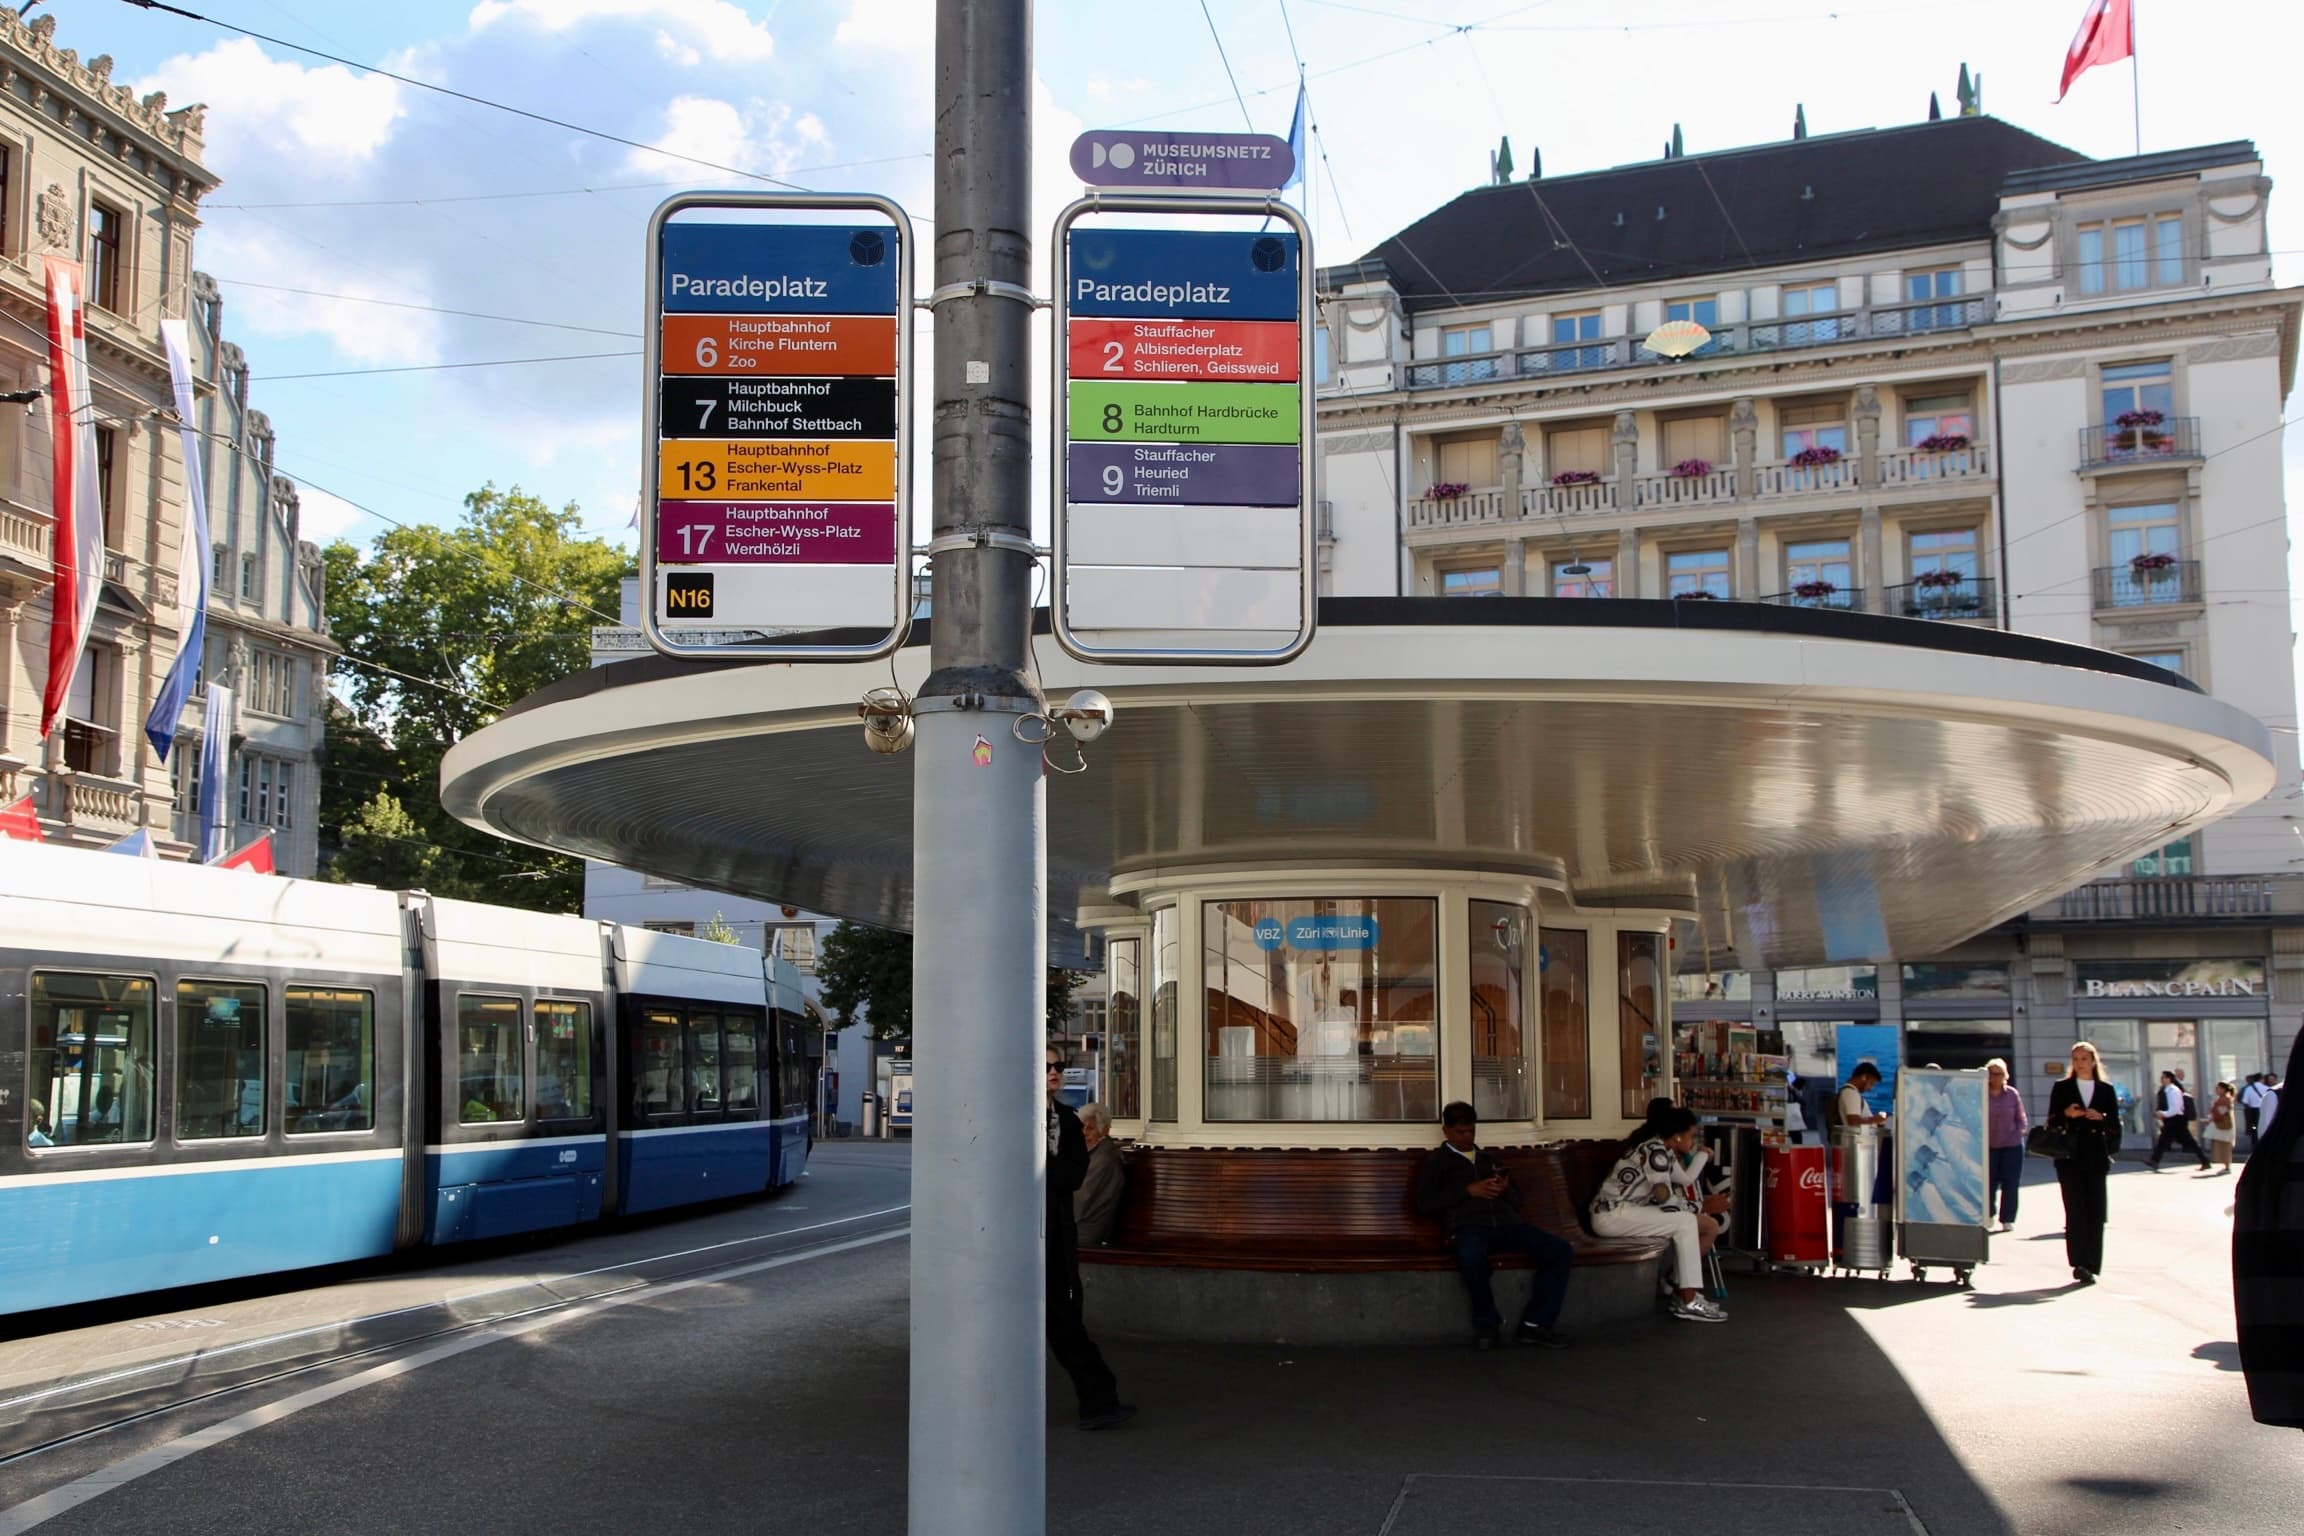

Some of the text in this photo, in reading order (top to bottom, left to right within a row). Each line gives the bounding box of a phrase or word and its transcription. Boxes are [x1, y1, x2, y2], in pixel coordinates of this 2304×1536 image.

[1143, 144, 1271, 159] MUSEUMSNETZ
[1143, 160, 1207, 176] ZÜRICH
[672, 274, 828, 301] Paradeplatz
[1078, 279, 1230, 307] Paradeplatz
[729, 321, 831, 335] Hauptbahnhof
[1134, 325, 1215, 338] Stauffacher
[729, 338, 837, 350] Kirche Fluntern
[1134, 343, 1243, 358] Albisriederplatz
[696, 337, 718, 368] 6
[1103, 342, 1124, 372] 2
[728, 356, 756, 367] Zoo
[1134, 360, 1279, 375] Schlieren, Geissweid
[728, 383, 831, 397] Hauptbahnhof
[728, 400, 802, 412] Milchbuck
[1134, 405, 1278, 419] Bahnhof Hardbrücke
[696, 399, 717, 430] 7
[1102, 404, 1123, 433] 8
[728, 418, 862, 430] Bahnhof Stettbach
[1134, 423, 1200, 434] Hardturm
[727, 444, 830, 458] Hauptbahnhof
[1134, 449, 1216, 462] Stauffacher
[676, 461, 716, 491] 13
[727, 462, 862, 476] Escher-Wyss-Platz
[1134, 467, 1189, 479] Heuried
[727, 480, 802, 491] Frankental
[1102, 465, 1123, 496] 9
[1134, 484, 1180, 496] Triemli
[726, 507, 829, 521] Hauptbahnhof
[676, 524, 715, 554] 17
[726, 525, 861, 540] Escher-Wyss-Platz
[725, 543, 800, 555] Werdhölzli
[670, 589, 710, 608] N16
[1256, 928, 1281, 940] VBZ
[1296, 927, 1369, 939] Züri Linie
[2085, 977, 2256, 997] BLANCPAIN
